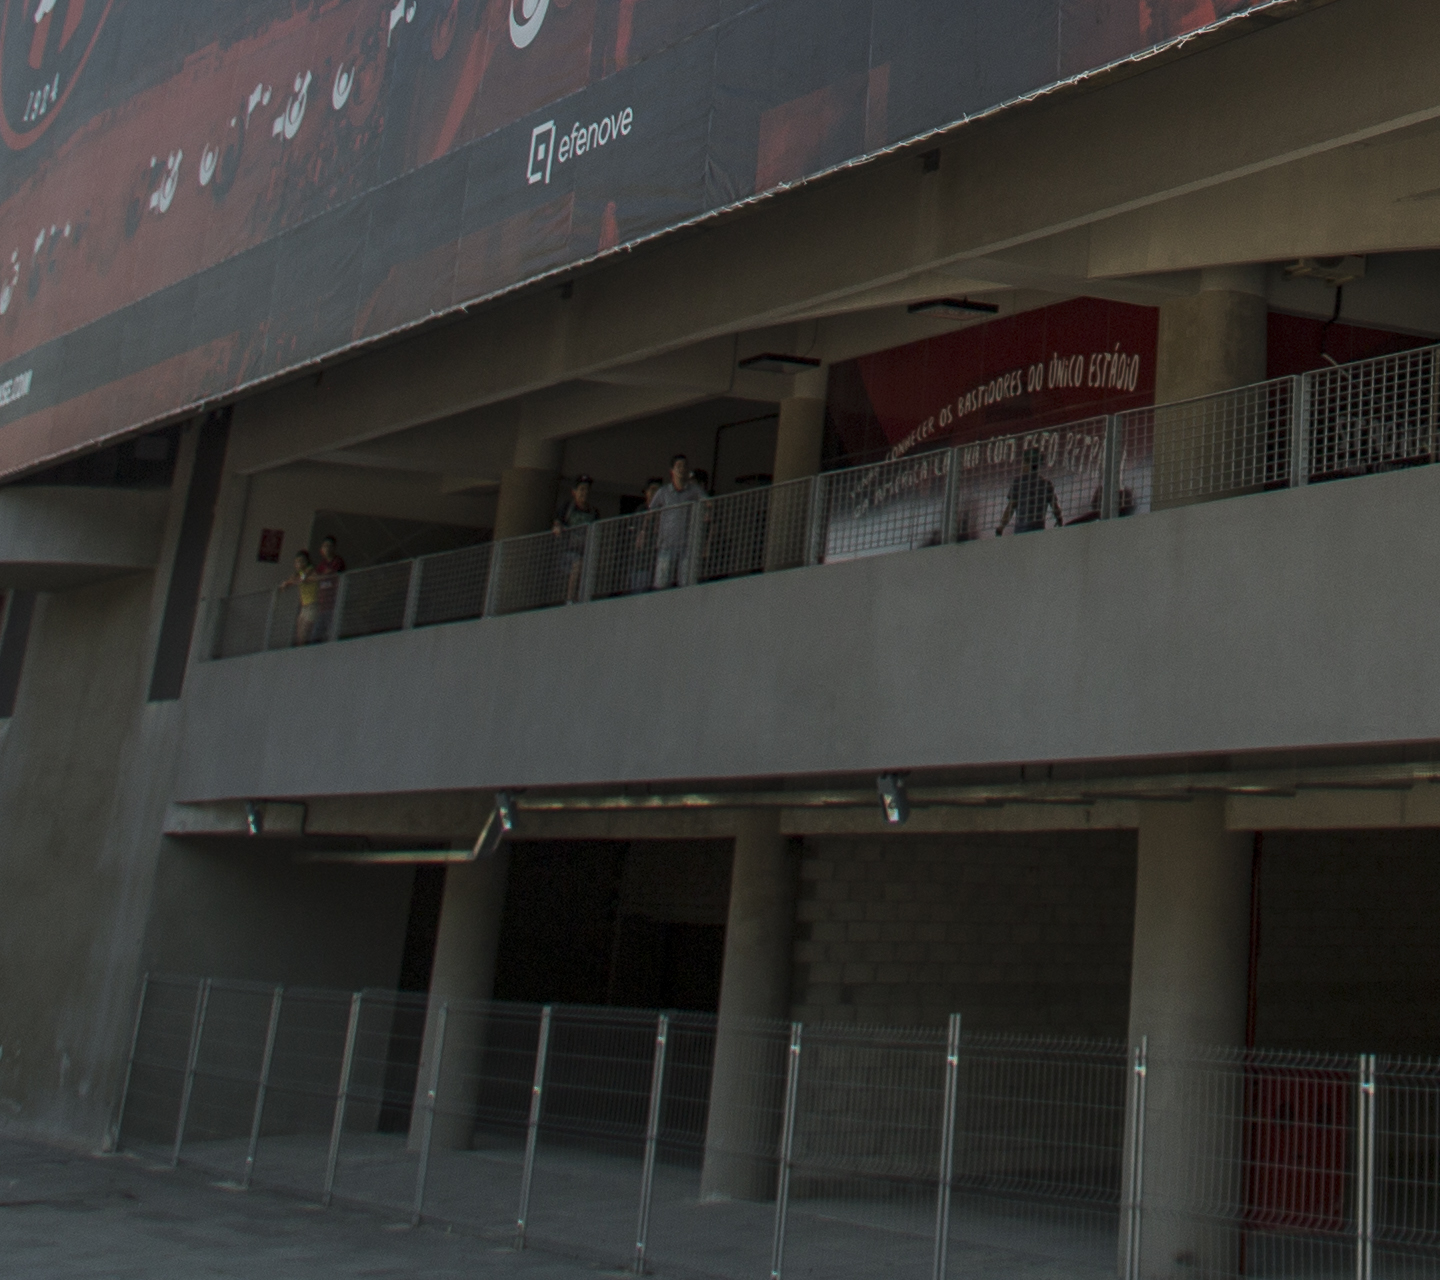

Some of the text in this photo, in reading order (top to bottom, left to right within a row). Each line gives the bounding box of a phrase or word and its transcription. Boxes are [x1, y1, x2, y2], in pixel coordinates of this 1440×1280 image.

[22, 72, 60, 125] 1924
[557, 106, 634, 163] efenove
[939, 404, 953, 428] OS
[1027, 362, 1044, 393] DO
